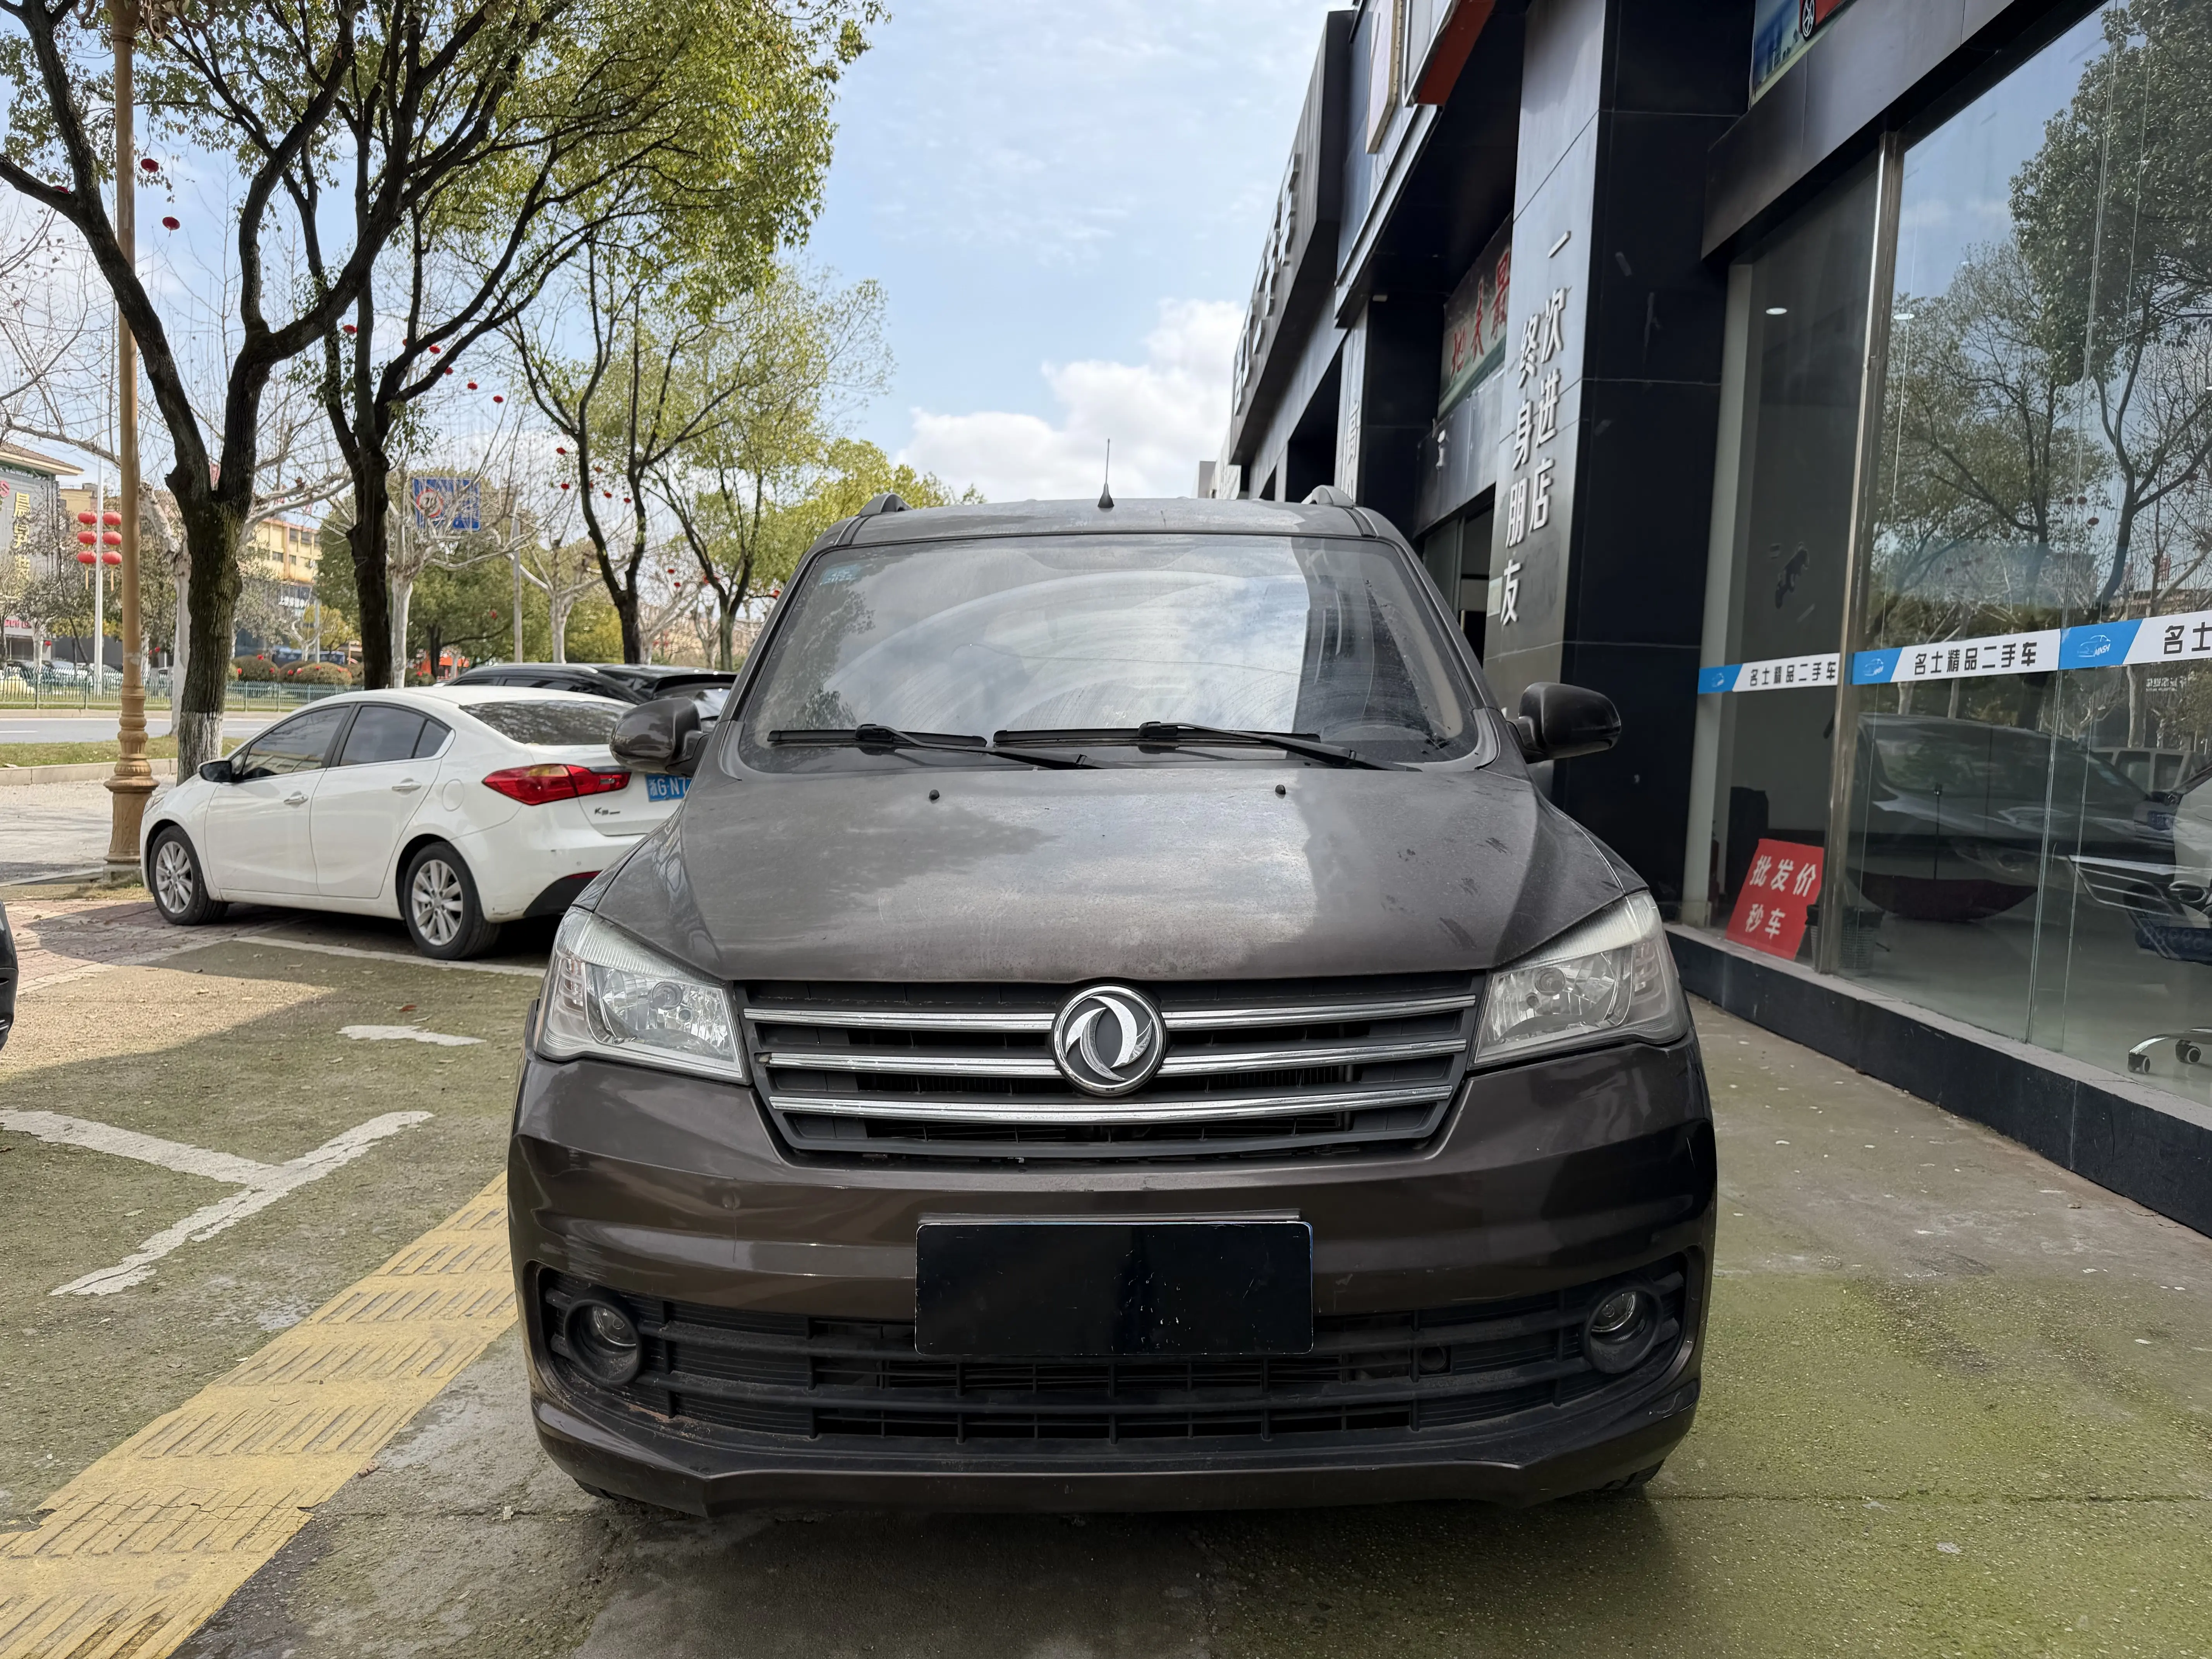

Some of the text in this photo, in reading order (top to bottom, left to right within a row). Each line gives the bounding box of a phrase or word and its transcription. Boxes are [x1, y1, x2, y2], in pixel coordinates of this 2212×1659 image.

[1528, 231, 1571, 532] 一次进店
[1500, 313, 1541, 626] 终身朋友
[1914, 641, 2037, 675] 名士精品二手车
[2164, 622, 2212, 655] 名士
[1749, 854, 1817, 897] 批发价
